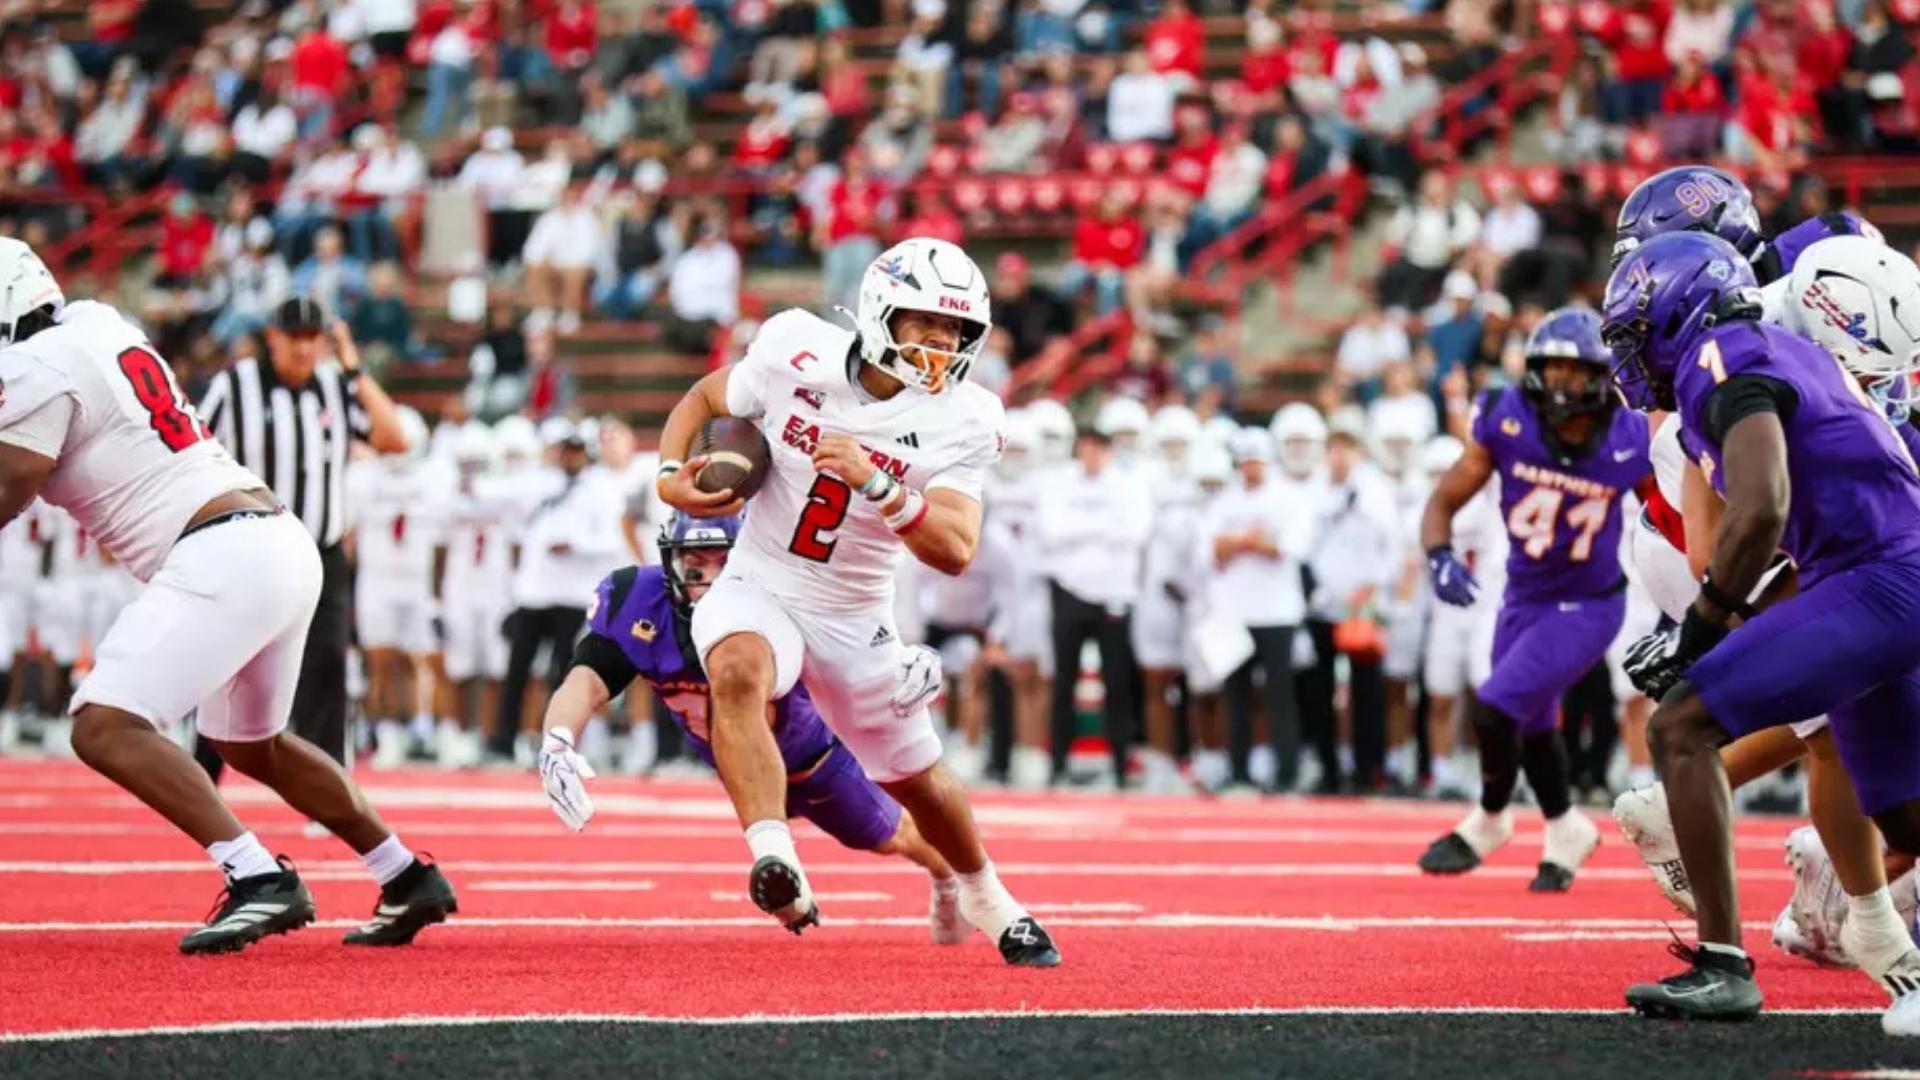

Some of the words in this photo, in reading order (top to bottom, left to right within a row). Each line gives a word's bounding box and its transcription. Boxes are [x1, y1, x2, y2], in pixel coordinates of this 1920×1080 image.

[1675, 173, 1728, 217] 90
[938, 295, 970, 311] EKG
[789, 350, 818, 372] C
[1697, 339, 1728, 384] 1
[117, 346, 214, 453] 8
[784, 414, 911, 478] EARN
[788, 472, 852, 563] 2
